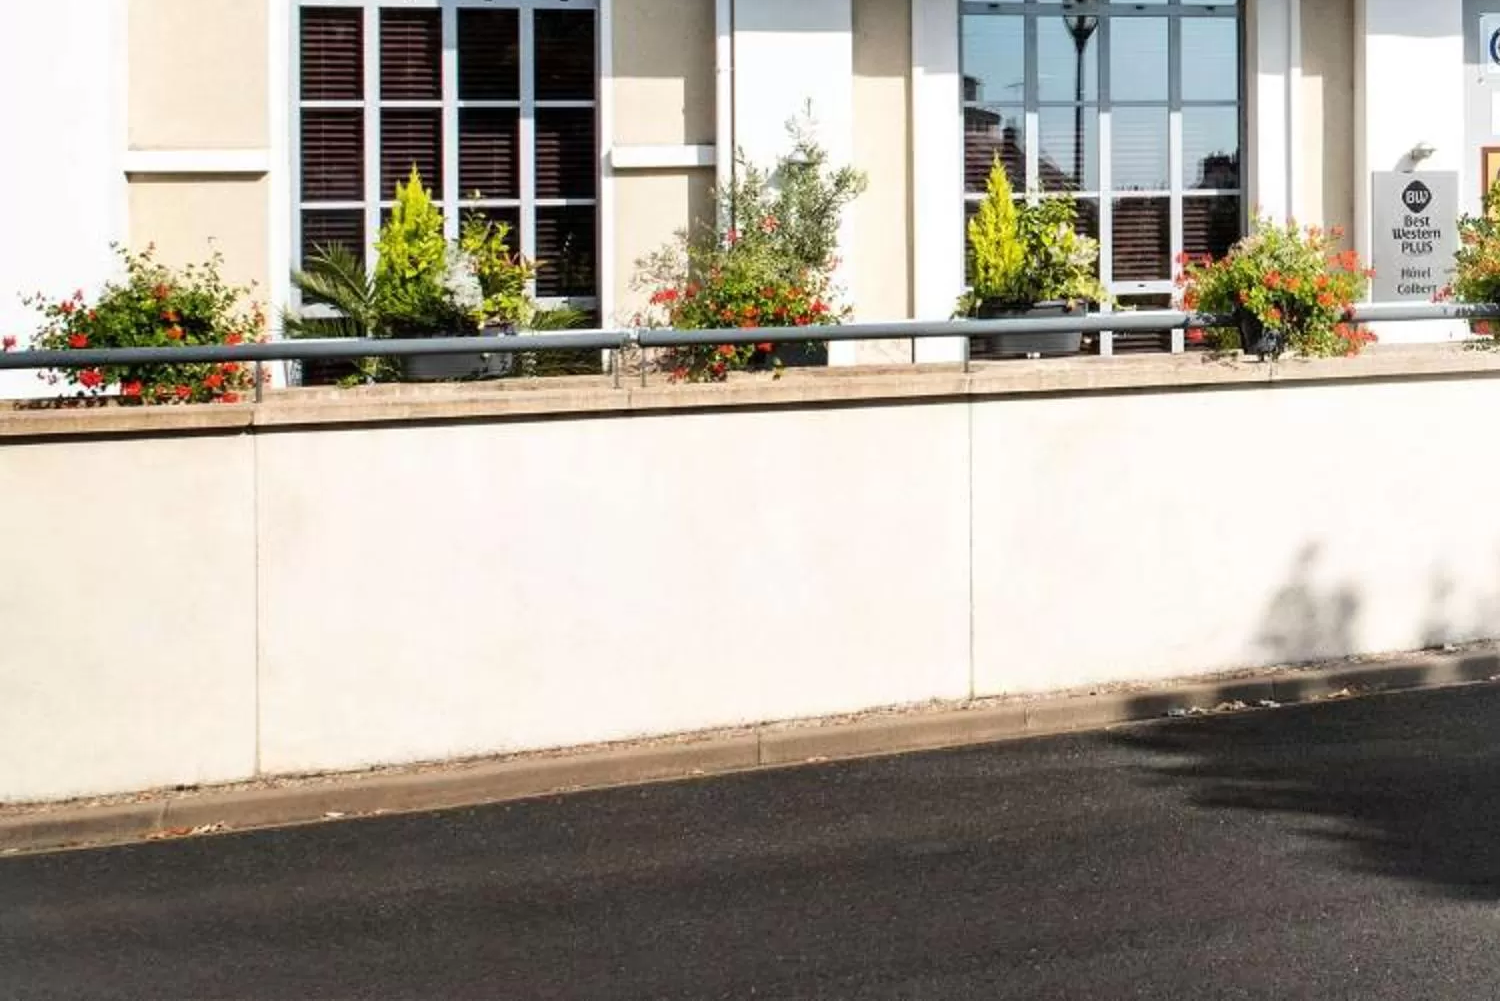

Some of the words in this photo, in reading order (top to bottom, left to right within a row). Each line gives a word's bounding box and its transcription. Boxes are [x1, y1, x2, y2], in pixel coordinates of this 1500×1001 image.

[1405, 190, 1429, 204] BW
[1404, 215, 1430, 227] Best
[1392, 228, 1441, 240] Western
[1402, 241, 1433, 254] PLUS
[1397, 283, 1437, 295] Colbert
